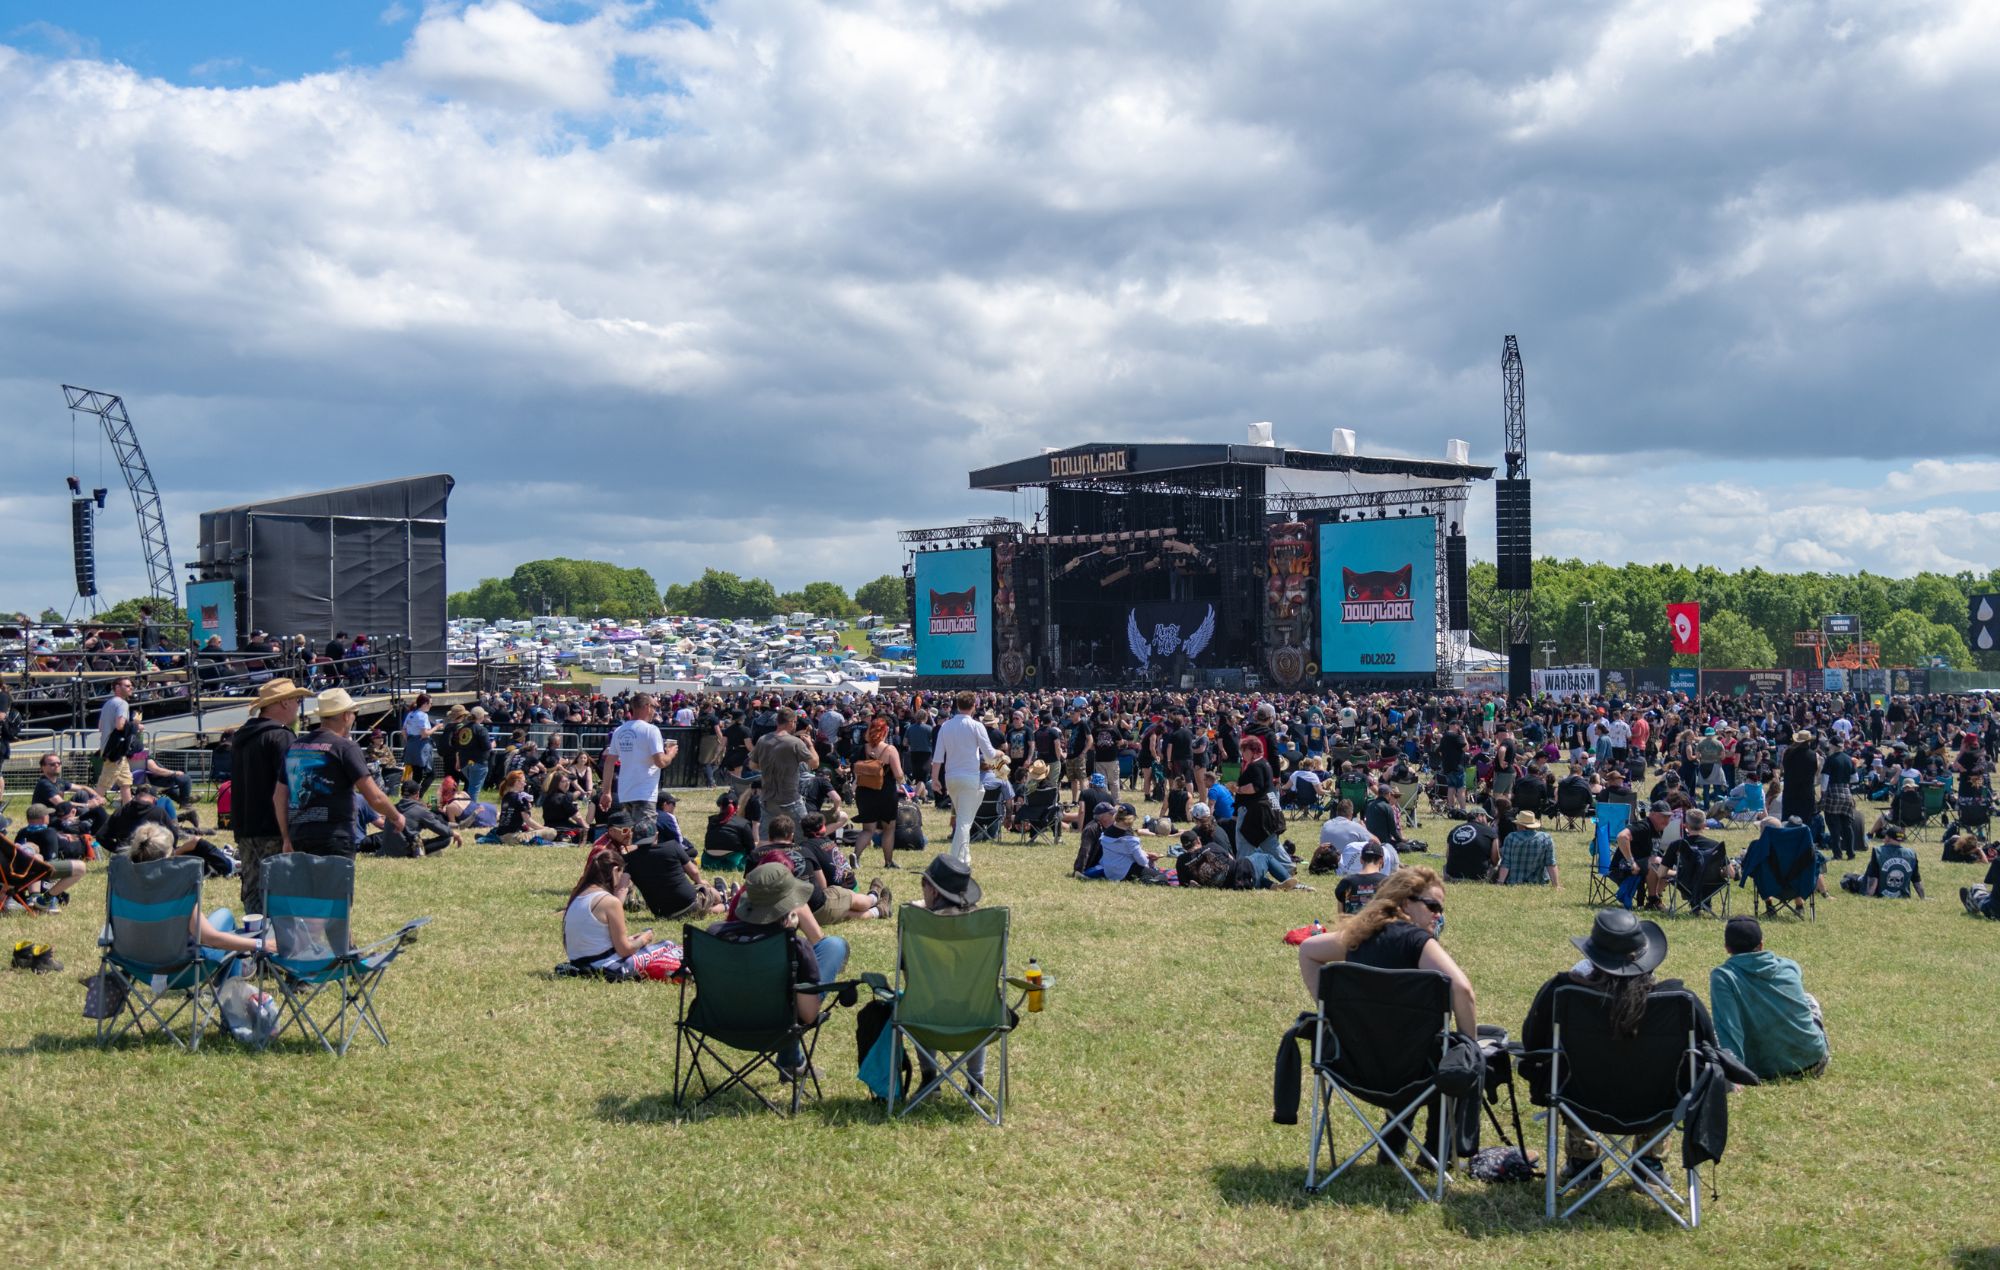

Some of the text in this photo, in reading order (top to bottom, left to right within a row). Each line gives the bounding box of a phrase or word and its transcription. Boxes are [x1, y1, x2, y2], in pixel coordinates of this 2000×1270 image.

[1050, 450, 1126, 478] DOWNLOAD
[1343, 602, 1412, 621] DOWNLOAD
[930, 618, 976, 633] DOWNLOAD
[941, 658, 965, 669] #DL2022
[1360, 653, 1396, 665] #DL2022
[1544, 672, 1596, 690] WARGASM
[1749, 673, 1765, 682] ALTER
[1670, 681, 1695, 689] Spiritbox
